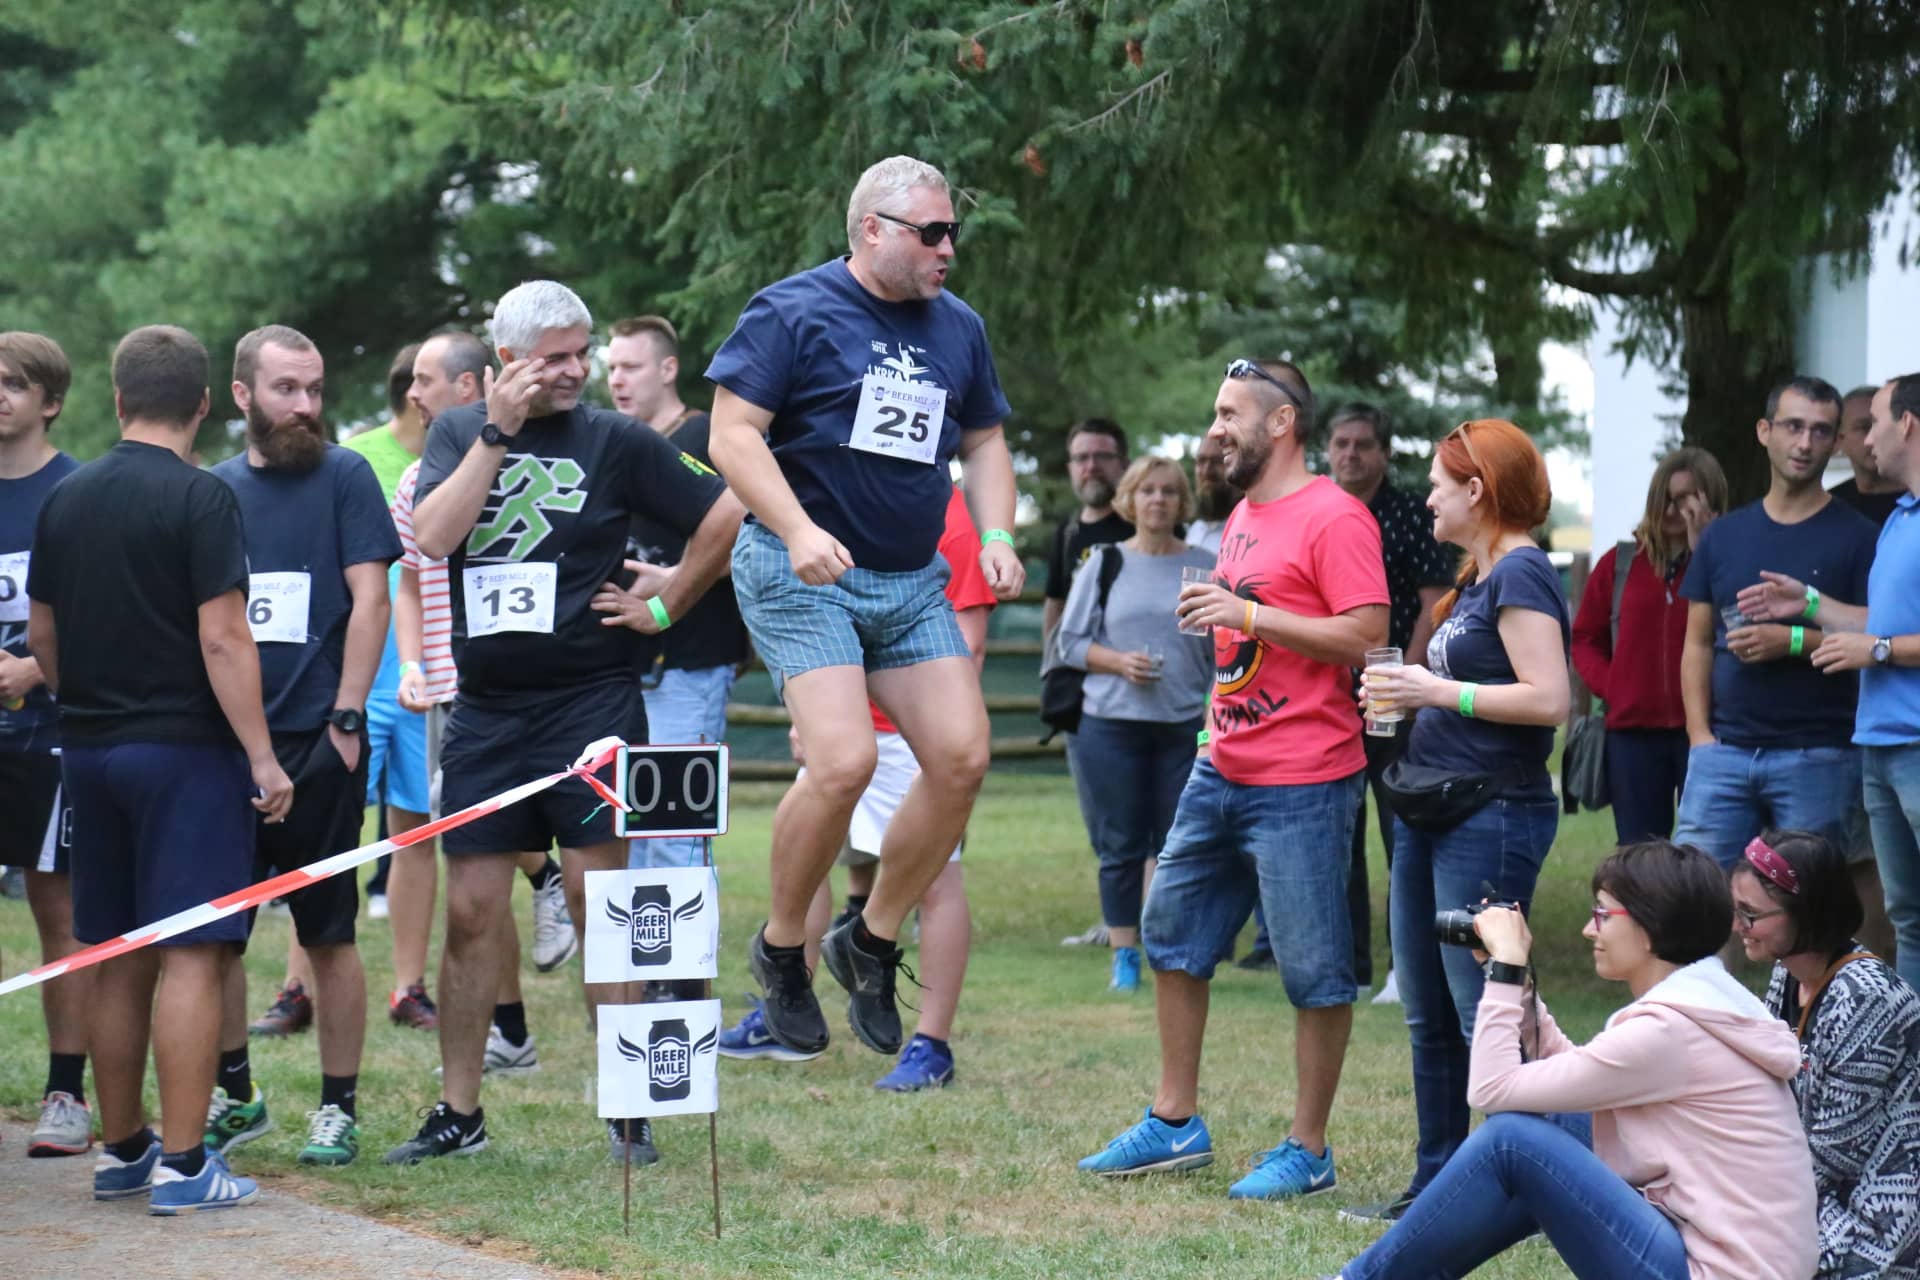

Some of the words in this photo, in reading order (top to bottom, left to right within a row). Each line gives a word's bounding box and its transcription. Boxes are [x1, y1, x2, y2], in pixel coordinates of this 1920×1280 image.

[872, 405, 930, 443] 25
[482, 586, 536, 617] 13
[628, 756, 716, 813] 0.0
[635, 914, 667, 928] BEER
[635, 927, 666, 940] MILE
[653, 1049, 686, 1063] BEER
[654, 1062, 685, 1076] MILE
